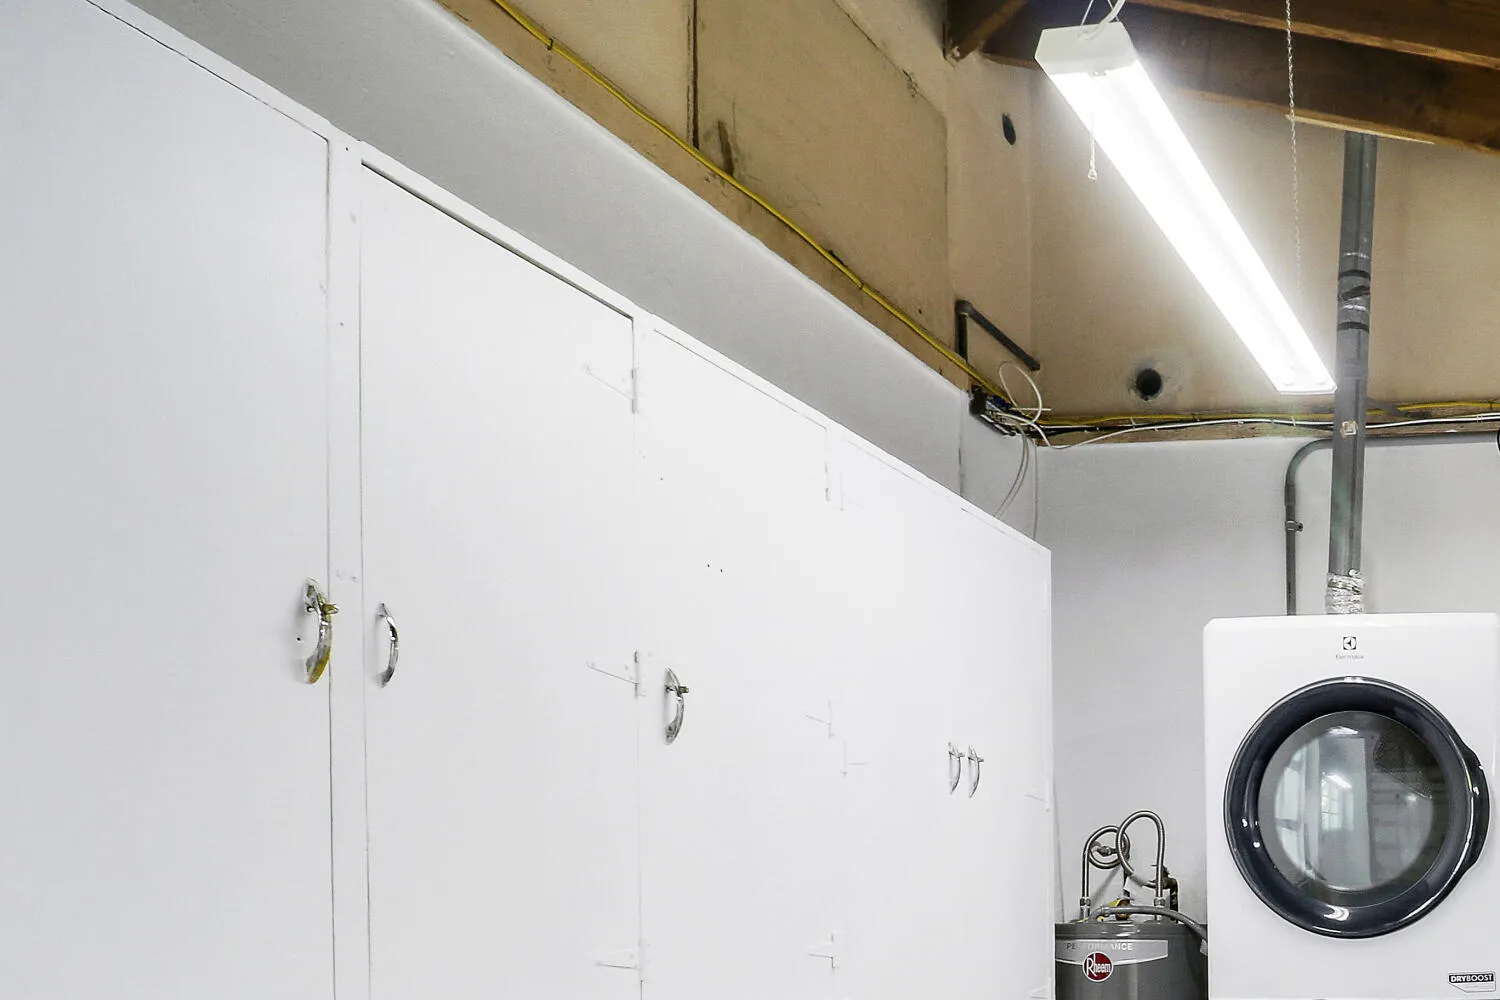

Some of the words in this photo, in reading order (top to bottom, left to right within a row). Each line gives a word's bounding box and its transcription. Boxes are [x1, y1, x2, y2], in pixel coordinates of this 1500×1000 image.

[1066, 942, 1133, 950] PERFORMANCE
[1086, 953, 1111, 977] Rheem
[1450, 974, 1493, 983] DRYBOOST
